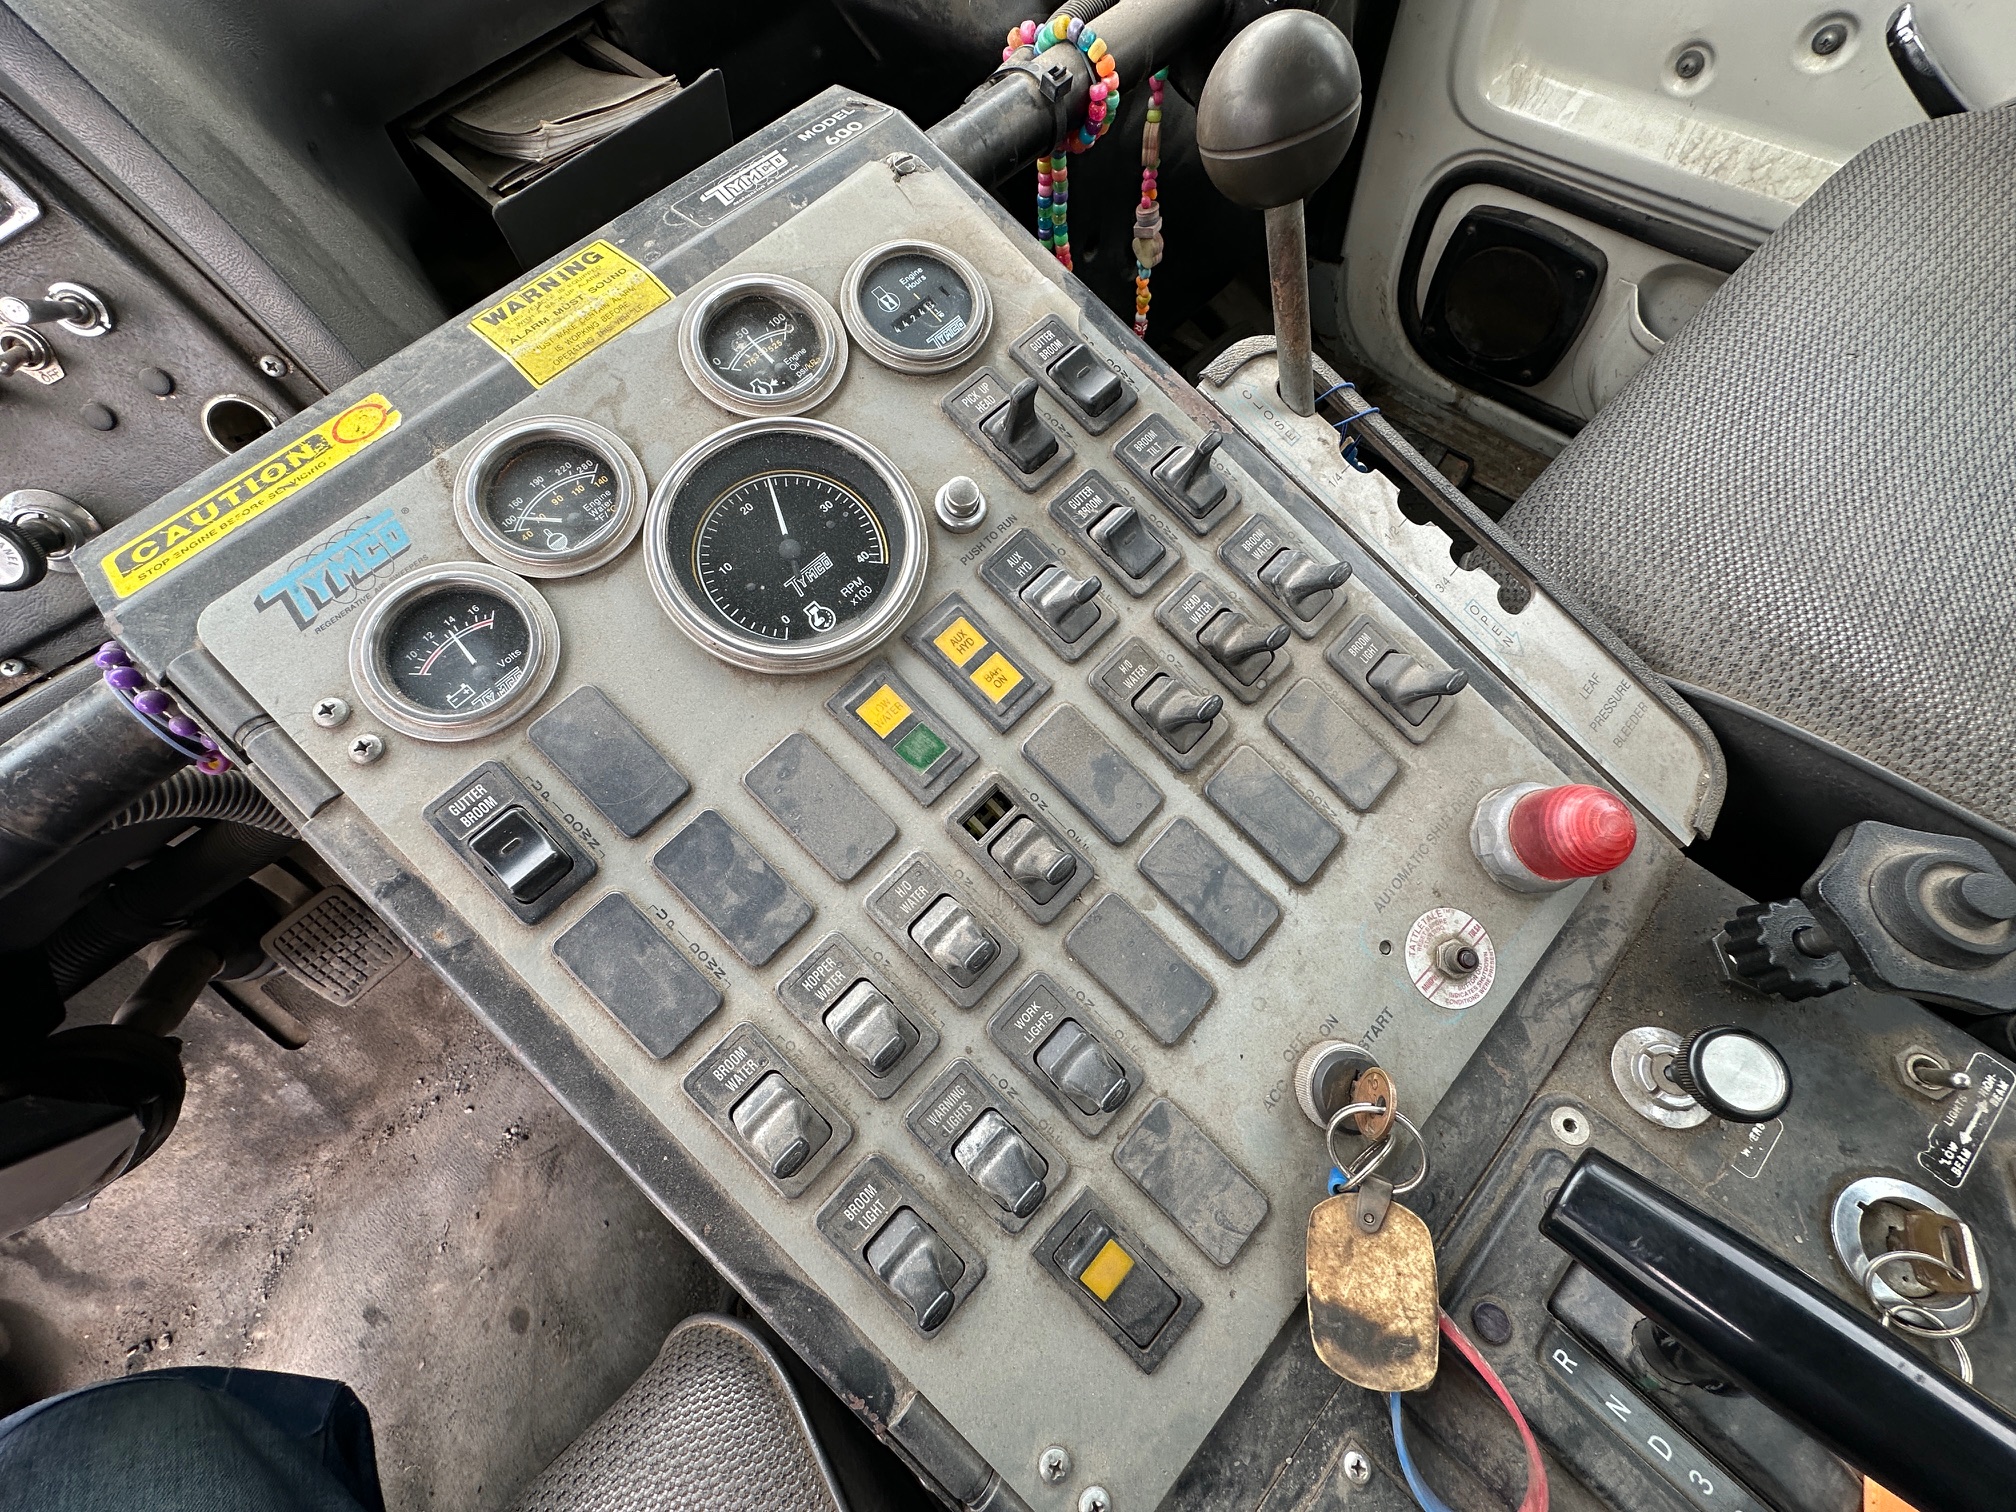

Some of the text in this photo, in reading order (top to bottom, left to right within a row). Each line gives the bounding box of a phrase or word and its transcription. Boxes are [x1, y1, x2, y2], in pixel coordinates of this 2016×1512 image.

[798, 108, 856, 142] MODEL
[826, 122, 862, 145] 600
[700, 150, 789, 206] TYMCO
[899, 268, 923, 286] Engine
[905, 274, 926, 290] Hours
[482, 251, 604, 326] WARNING
[507, 316, 550, 344] ALARM
[552, 293, 585, 316] MUST
[587, 267, 628, 294] SOUND
[553, 344, 564, 352] IS
[599, 301, 631, 322] BEFORE
[768, 314, 786, 328] 100
[736, 327, 749, 340] 50
[1029, 330, 1056, 352] GUTTER
[551, 336, 595, 366] OPERATING
[768, 340, 782, 352] 525
[784, 348, 806, 366] Engine
[1039, 340, 1064, 360] BROOM
[713, 358, 721, 366] 0
[744, 358, 756, 368] 175
[790, 361, 800, 370] Oil
[962, 382, 990, 408] PICK UP
[975, 396, 996, 414] HEAD
[1242, 389, 1296, 442] CLOSE
[1134, 430, 1158, 452] BROOM
[1146, 442, 1163, 457] TILT
[555, 462, 572, 476] 220
[576, 460, 594, 474] 280
[529, 476, 544, 488] 190
[572, 485, 585, 496] 110
[594, 476, 608, 488] 140
[1328, 474, 1343, 488] 1/4
[131, 444, 316, 564] CAUTION
[508, 497, 524, 510] 160
[551, 495, 564, 506] 90
[583, 490, 612, 512] Engine
[588, 500, 613, 518] Water
[740, 502, 754, 516] 20
[820, 500, 834, 513] 30
[1068, 485, 1095, 511] GUTTER
[1078, 495, 1104, 519] BROOM
[502, 515, 516, 528] 100
[522, 530, 534, 541] 40
[960, 515, 1018, 566] PUSH TO RUN
[1242, 528, 1266, 552] BROOM
[1384, 526, 1400, 540] 1/2
[138, 557, 170, 581] STOP
[173, 528, 218, 558] ENGINE
[856, 550, 870, 564] 40
[1006, 552, 1024, 568] AUX
[1252, 538, 1274, 560] WATER
[253, 508, 412, 632] TYMCO
[718, 562, 733, 576] 10
[784, 552, 833, 598] TYMCO
[1016, 561, 1033, 578] HYD
[314, 594, 372, 634] REGENERATIVE
[389, 554, 429, 582] SWEEPERS
[840, 576, 864, 598] RPM
[850, 586, 873, 606] x100
[1435, 578, 1450, 593] 3/4
[468, 604, 480, 615] 16
[1182, 594, 1200, 614] HEAD
[1189, 602, 1213, 624] WATER
[444, 616, 456, 626] 14
[781, 615, 790, 624] 0
[1468, 604, 1514, 648] OPEN
[422, 631, 434, 642] 12
[950, 629, 968, 647] AUX
[956, 637, 975, 654] HYD
[1348, 632, 1372, 657] BROOM
[405, 651, 418, 660] 10
[496, 649, 522, 668] Volts
[1360, 644, 1379, 664] LIGHT
[1118, 660, 1133, 674] H/O
[1122, 665, 1148, 688] WATER
[994, 674, 1008, 689] ON
[1579, 672, 1601, 700] LEAF
[871, 698, 890, 716] LOW
[874, 701, 904, 728] WATER
[1590, 678, 1632, 733] PRESSURE
[1612, 702, 1648, 749] BLEEDER
[448, 784, 488, 816] GUTTER
[1029, 792, 1048, 812] ON
[460, 795, 498, 828] BROOM
[532, 781, 600, 850] UP DOWN
[895, 880, 912, 898] H/O
[1373, 843, 1430, 914] AUTOMATIC
[900, 885, 929, 914] WATER
[656, 908, 728, 980] UP DOWN
[802, 956, 837, 992] HOPPER
[1449, 952, 1488, 998] INDICATES SHUTDOWN
[1458, 975, 1478, 991] BUTTON
[815, 970, 846, 1002] WATER
[1445, 992, 1480, 1005] CONDITIONS
[1480, 978, 1490, 994] WERE
[1076, 990, 1095, 1008] ON
[1014, 1002, 1041, 1030] WORK
[1024, 1010, 1054, 1042] LIGHTS
[1319, 1014, 1338, 1037] ON
[1358, 1006, 1394, 1051] START
[712, 1046, 748, 1082] BROOM
[724, 1059, 758, 1092] WATER
[998, 1078, 1018, 1099] ON
[1263, 1079, 1290, 1112] ACC
[1989, 1077, 2010, 1108] BEAM
[927, 1084, 966, 1127] WARNING
[1944, 1094, 1968, 1127] LIGHTS
[943, 1102, 973, 1134] LIGHTS
[1950, 1148, 1972, 1178] BEAM
[843, 1184, 878, 1222] BROOM
[858, 1199, 886, 1230] LIGHT
[1552, 1349, 1714, 1495] R N D 3
